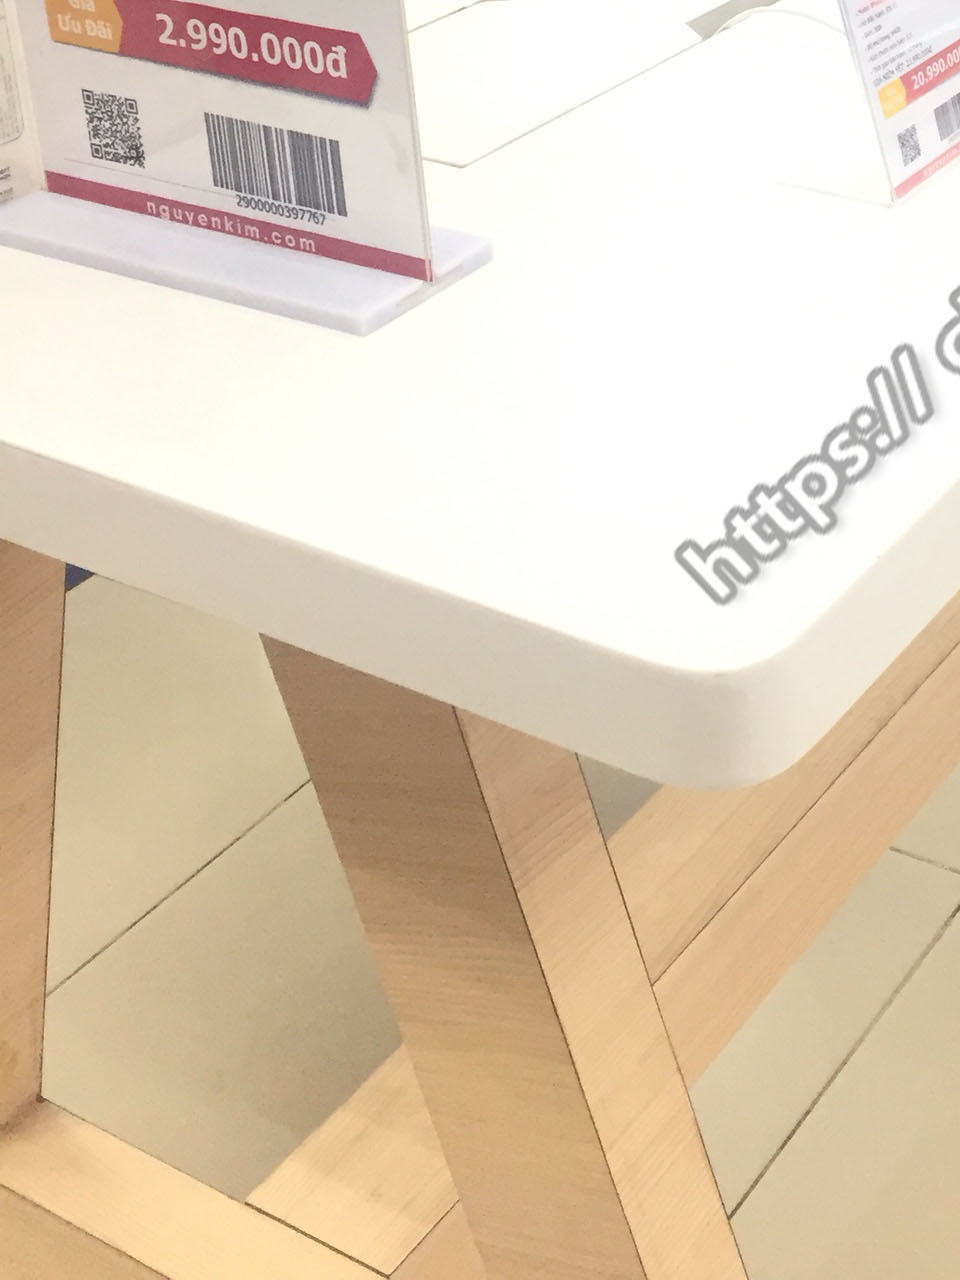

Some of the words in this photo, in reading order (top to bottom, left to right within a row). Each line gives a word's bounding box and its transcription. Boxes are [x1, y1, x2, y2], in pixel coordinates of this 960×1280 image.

[57, 12, 81, 34] Ưu
[83, 17, 113, 41] Đãi
[155, 13, 348, 79] 2.990.000đ
[146, 198, 317, 253] nguyenkim.com
[236, 194, 327, 226] 2900000397767
